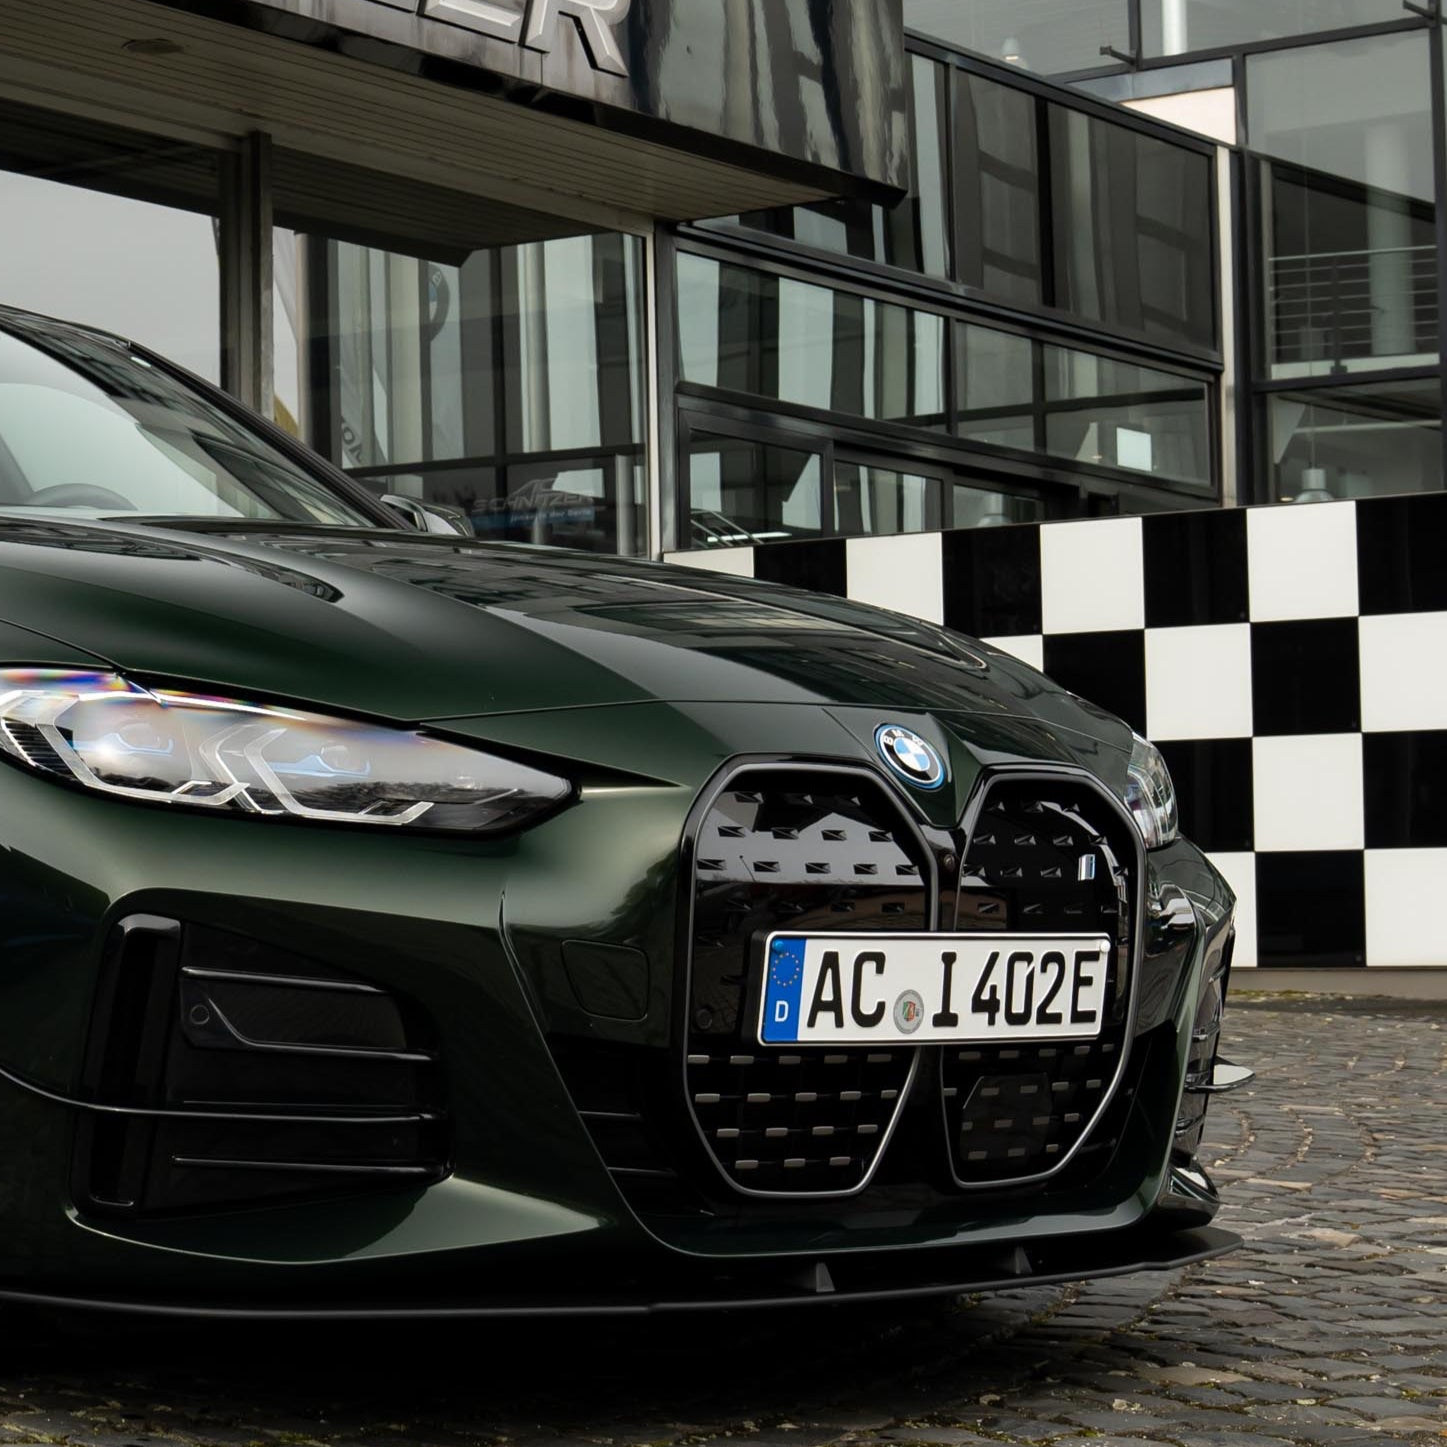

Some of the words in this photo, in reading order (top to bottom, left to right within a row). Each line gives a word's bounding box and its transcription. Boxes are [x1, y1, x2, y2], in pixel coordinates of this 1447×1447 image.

[775, 1000, 789, 1022] D
[807, 950, 886, 1028] AC
[971, 949, 1101, 1027] 402E
